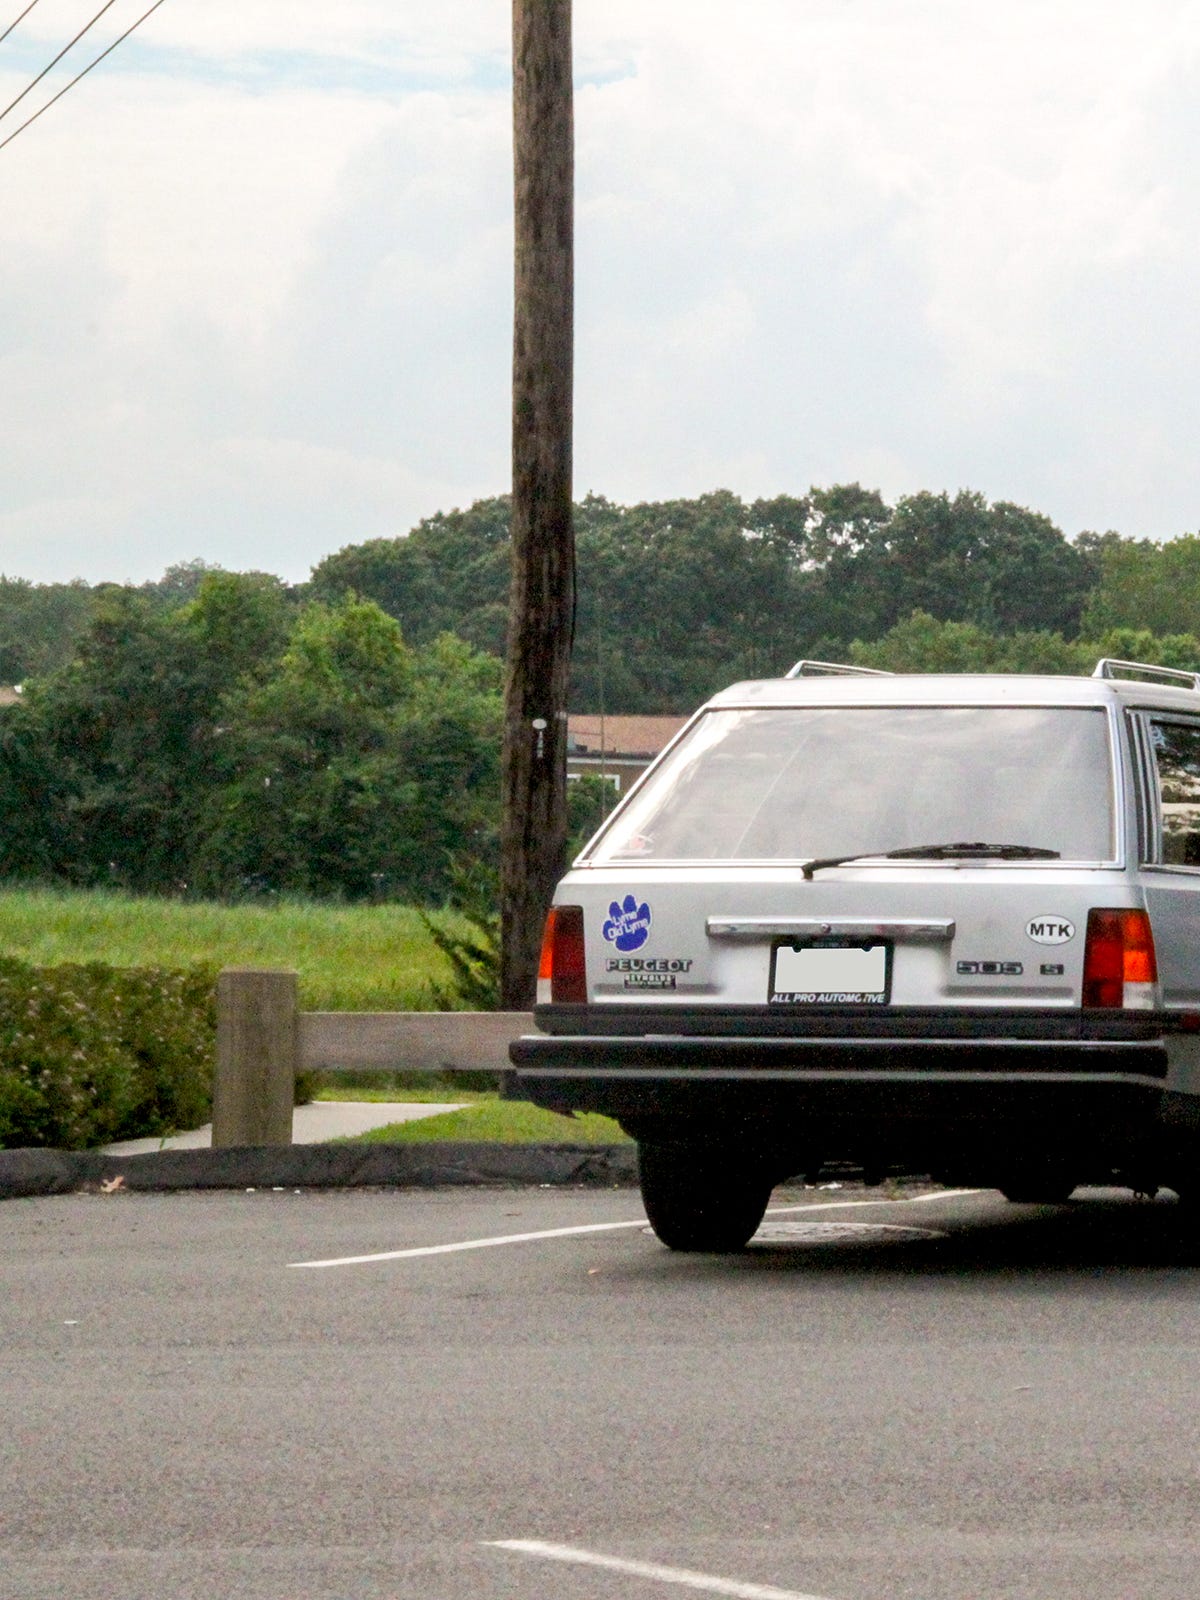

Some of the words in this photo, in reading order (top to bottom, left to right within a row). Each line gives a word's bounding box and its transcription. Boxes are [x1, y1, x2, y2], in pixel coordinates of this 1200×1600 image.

[613, 911, 637, 926] Lyme
[607, 926, 623, 938] Old
[625, 919, 648, 934] Lyme
[1030, 923, 1070, 937] MTK
[606, 959, 693, 972] PEUGEOT
[957, 961, 1023, 975] 505
[771, 993, 791, 1003] ALL
[793, 993, 817, 1003] PRO
